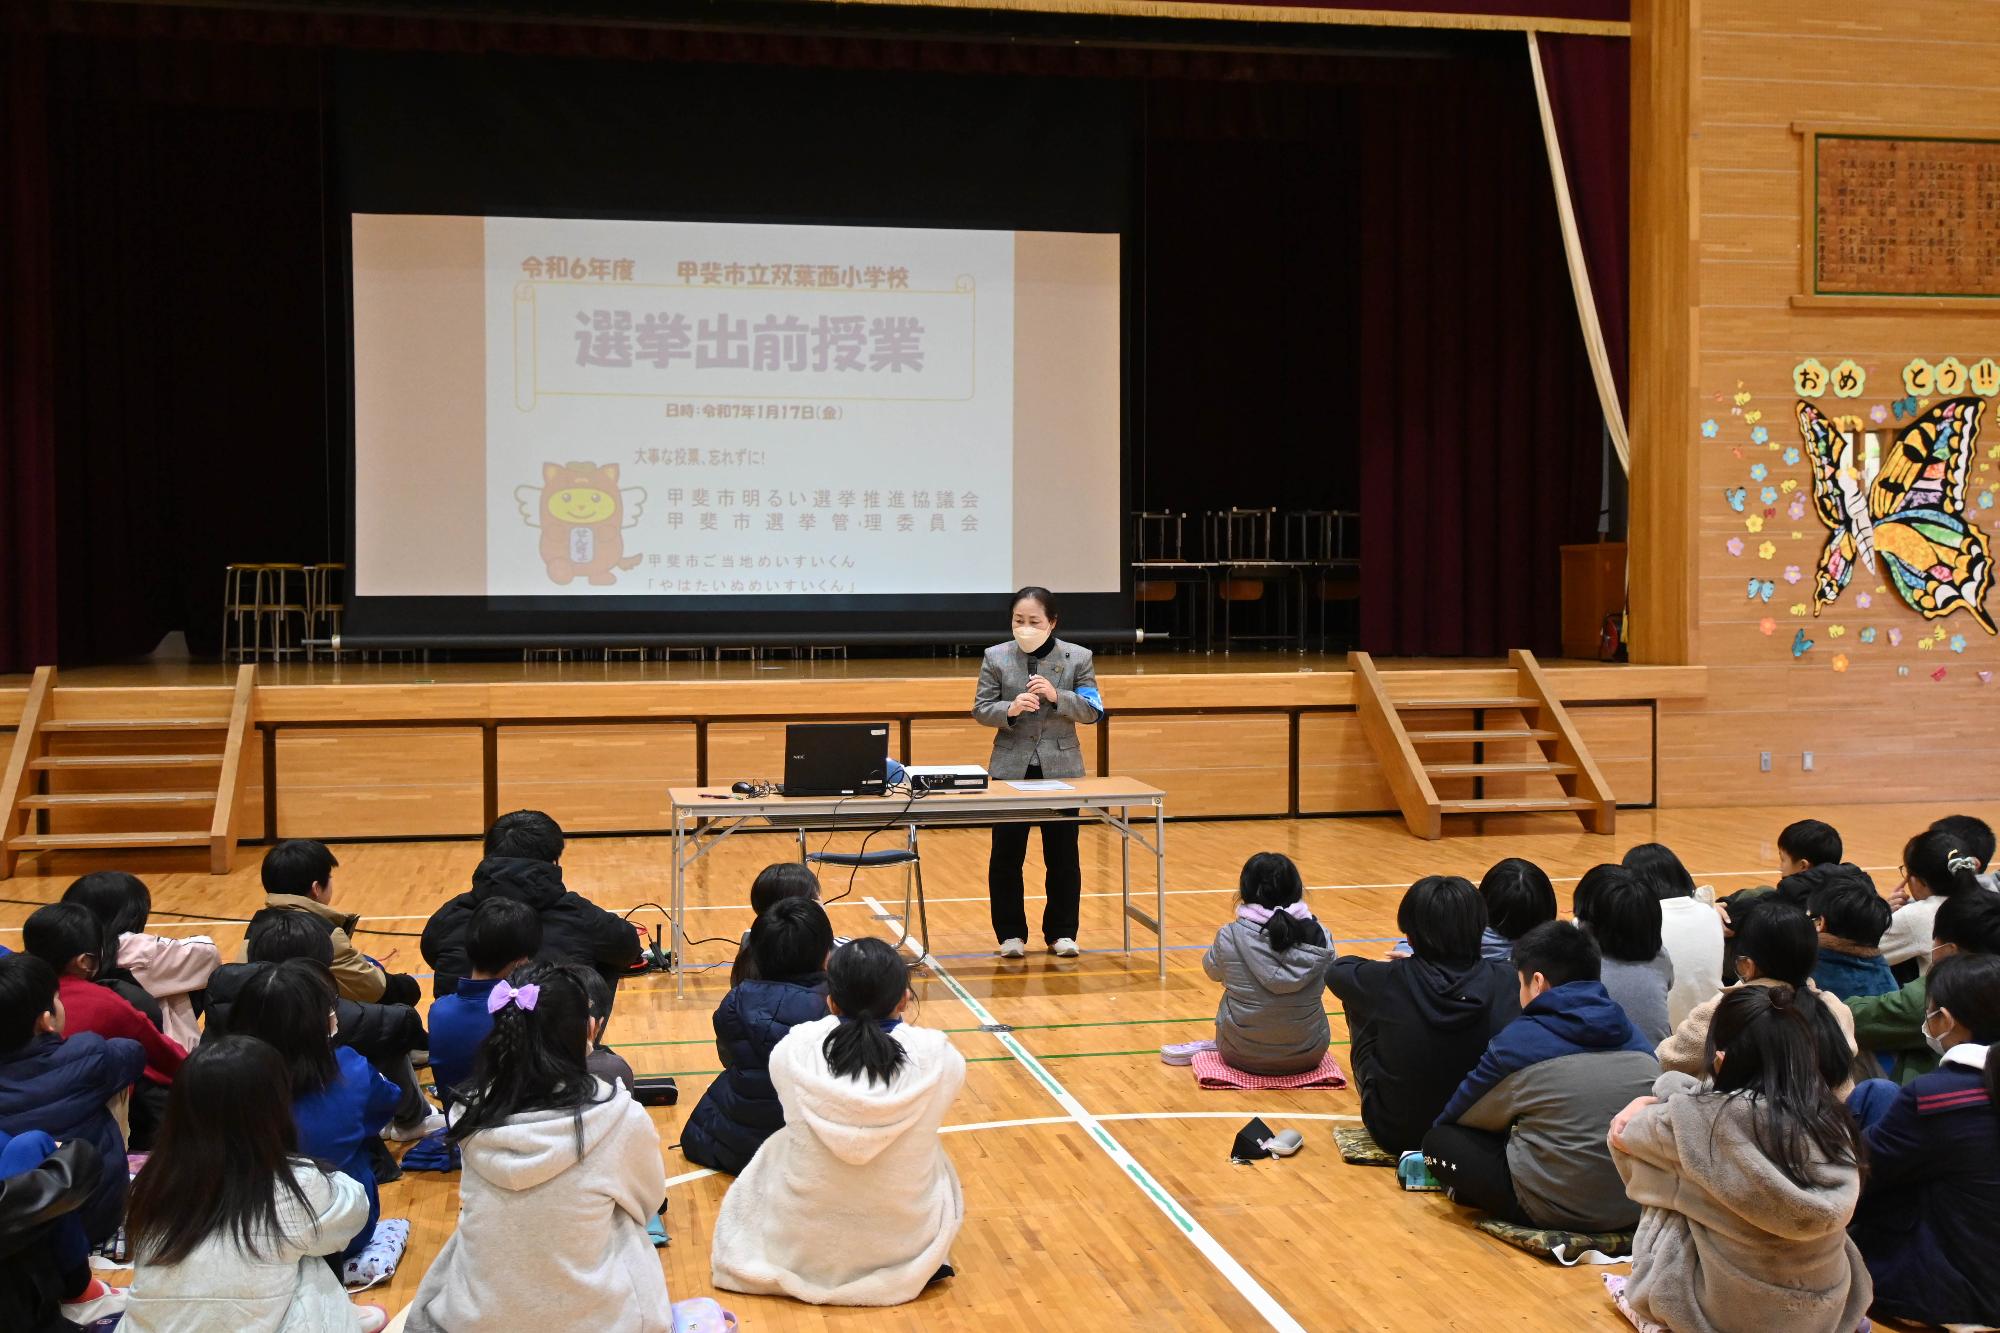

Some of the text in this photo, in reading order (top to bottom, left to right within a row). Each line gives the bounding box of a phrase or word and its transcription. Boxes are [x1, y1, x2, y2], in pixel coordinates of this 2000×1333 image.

[521, 255, 910, 289] 令和6年度 甲斐市立双葉西小学校
[574, 309, 926, 374] 選挙出前授業
[1799, 367, 1858, 391] おめ
[667, 487, 980, 509] 甲斐市明るい選挙推進協議会
[667, 511, 980, 532] 甲斐市選挙管理委員会
[648, 553, 856, 569] 甲斐市ご当地めいすいくん
